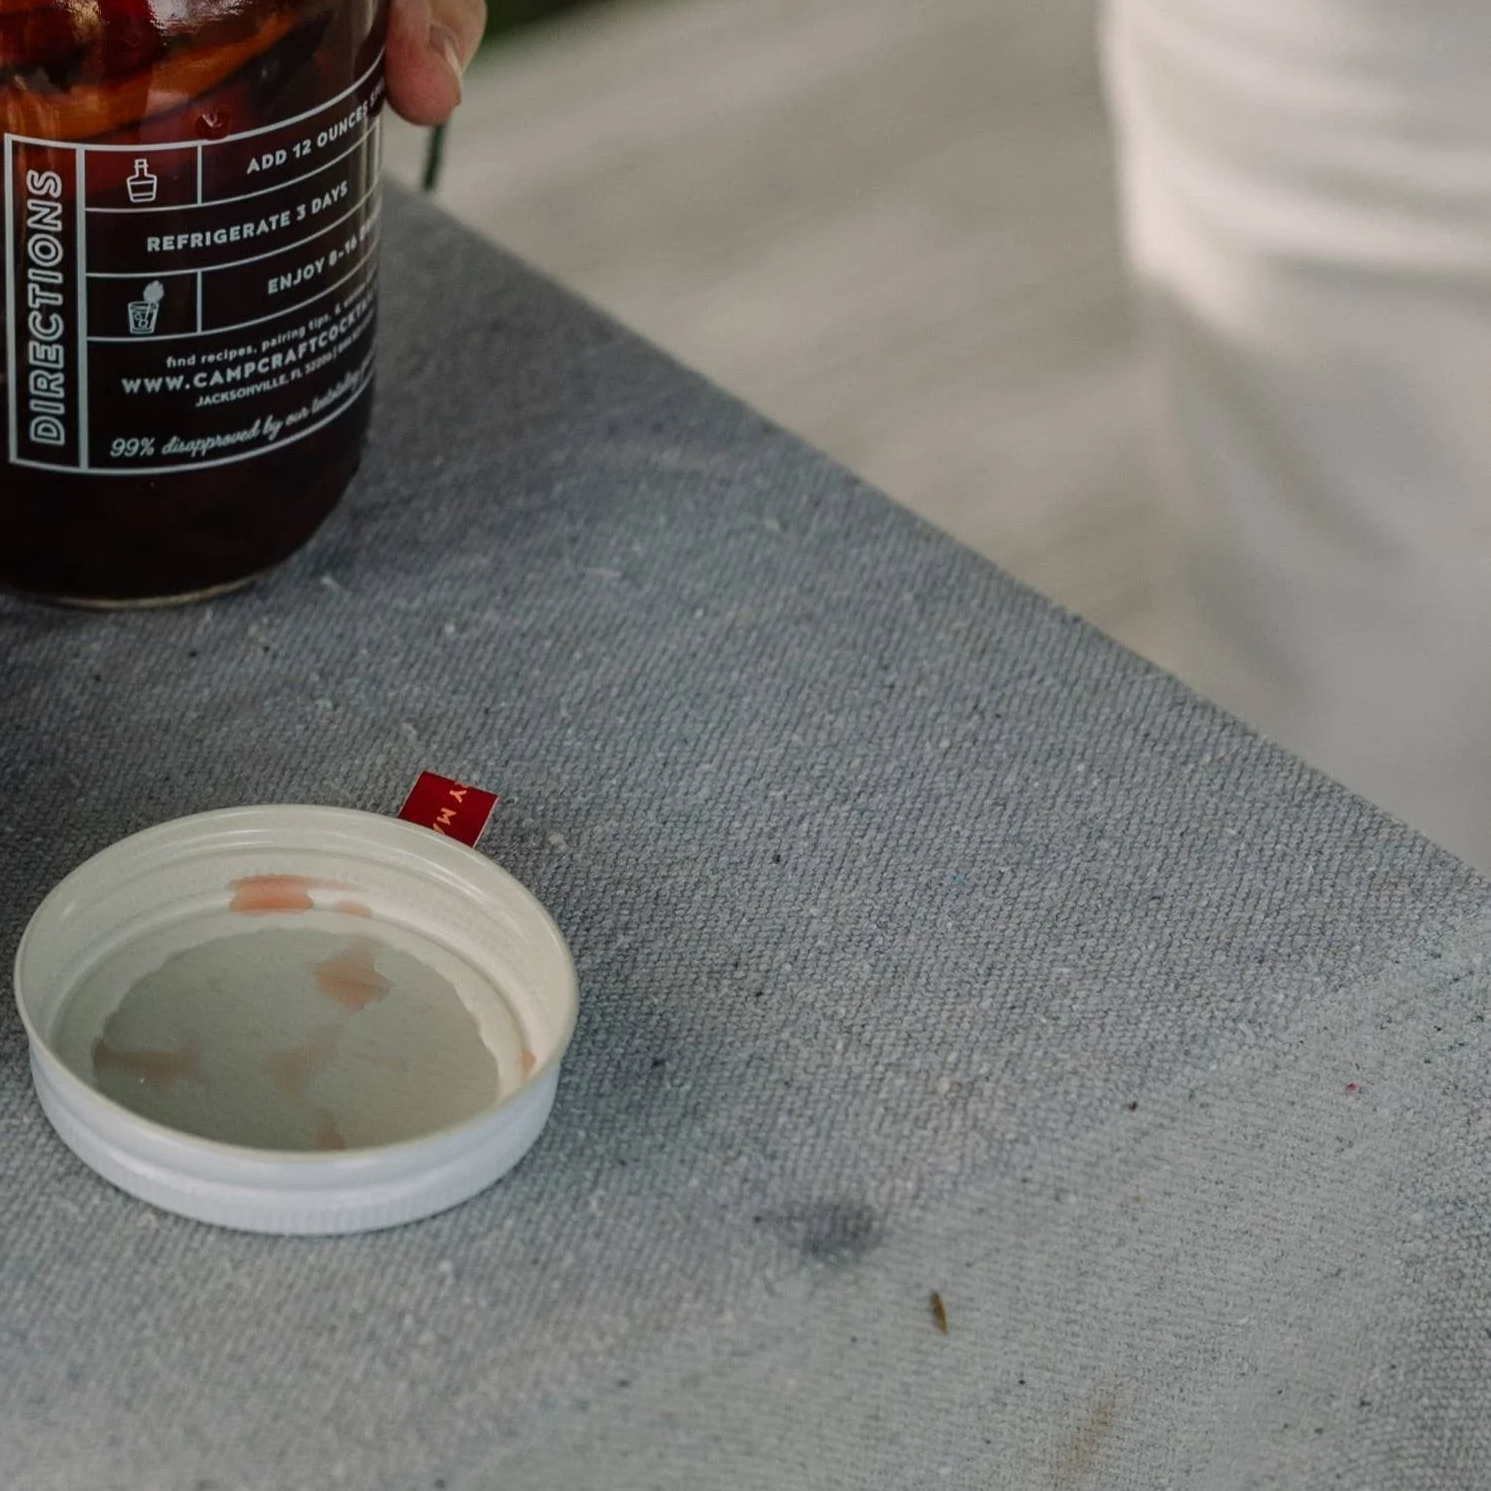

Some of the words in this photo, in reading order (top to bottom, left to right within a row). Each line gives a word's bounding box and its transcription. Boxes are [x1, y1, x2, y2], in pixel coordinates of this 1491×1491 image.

[246, 149, 288, 174] ADD
[292, 139, 313, 159] 12
[317, 100, 369, 149] OUNCES
[146, 210, 291, 253] REFRIGERATE
[296, 204, 307, 222] 3
[311, 180, 349, 215] DAYS
[267, 256, 325, 296] ENJOY
[27, 169, 66, 446] DIRECTIONS
[166, 354, 196, 370] find
[261, 328, 306, 353] pairing
[110, 437, 155, 458] 99%
[161, 418, 261, 458] disapproved
[262, 412, 284, 442] by
